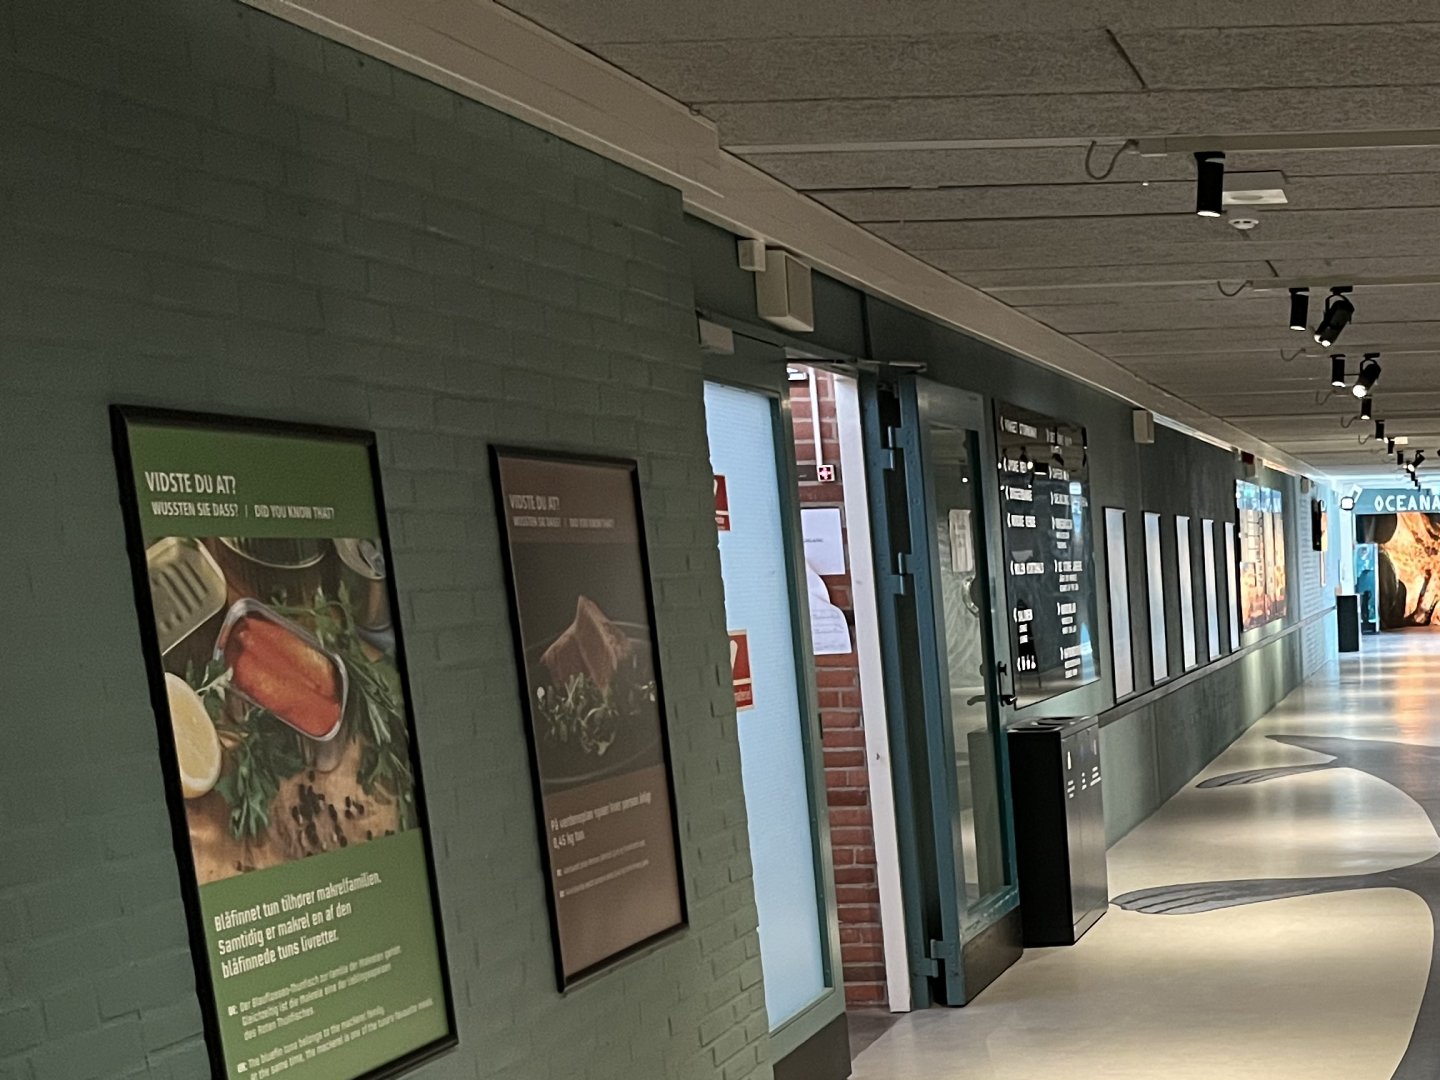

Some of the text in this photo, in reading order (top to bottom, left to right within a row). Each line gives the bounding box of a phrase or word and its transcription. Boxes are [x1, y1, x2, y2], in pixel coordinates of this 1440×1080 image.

[145, 472, 235, 494] VIDSTE DU AT?
[152, 502, 195, 515] WUSSTEN
[197, 503, 210, 516] SIE
[213, 504, 238, 517] DASS?
[254, 505, 269, 517] DID
[271, 505, 286, 517] YOU
[288, 506, 311, 518] KNOW
[509, 495, 535, 509] VIDSTE
[537, 496, 546, 510] DU
[214, 905, 260, 932] Blåfinnet
[263, 902, 280, 917] tun
[281, 891, 315, 911] tilhører
[218, 902, 352, 955] Samtidig er makrel en af den
[221, 949, 276, 979] blåfinnede
[278, 942, 299, 960] tuns
